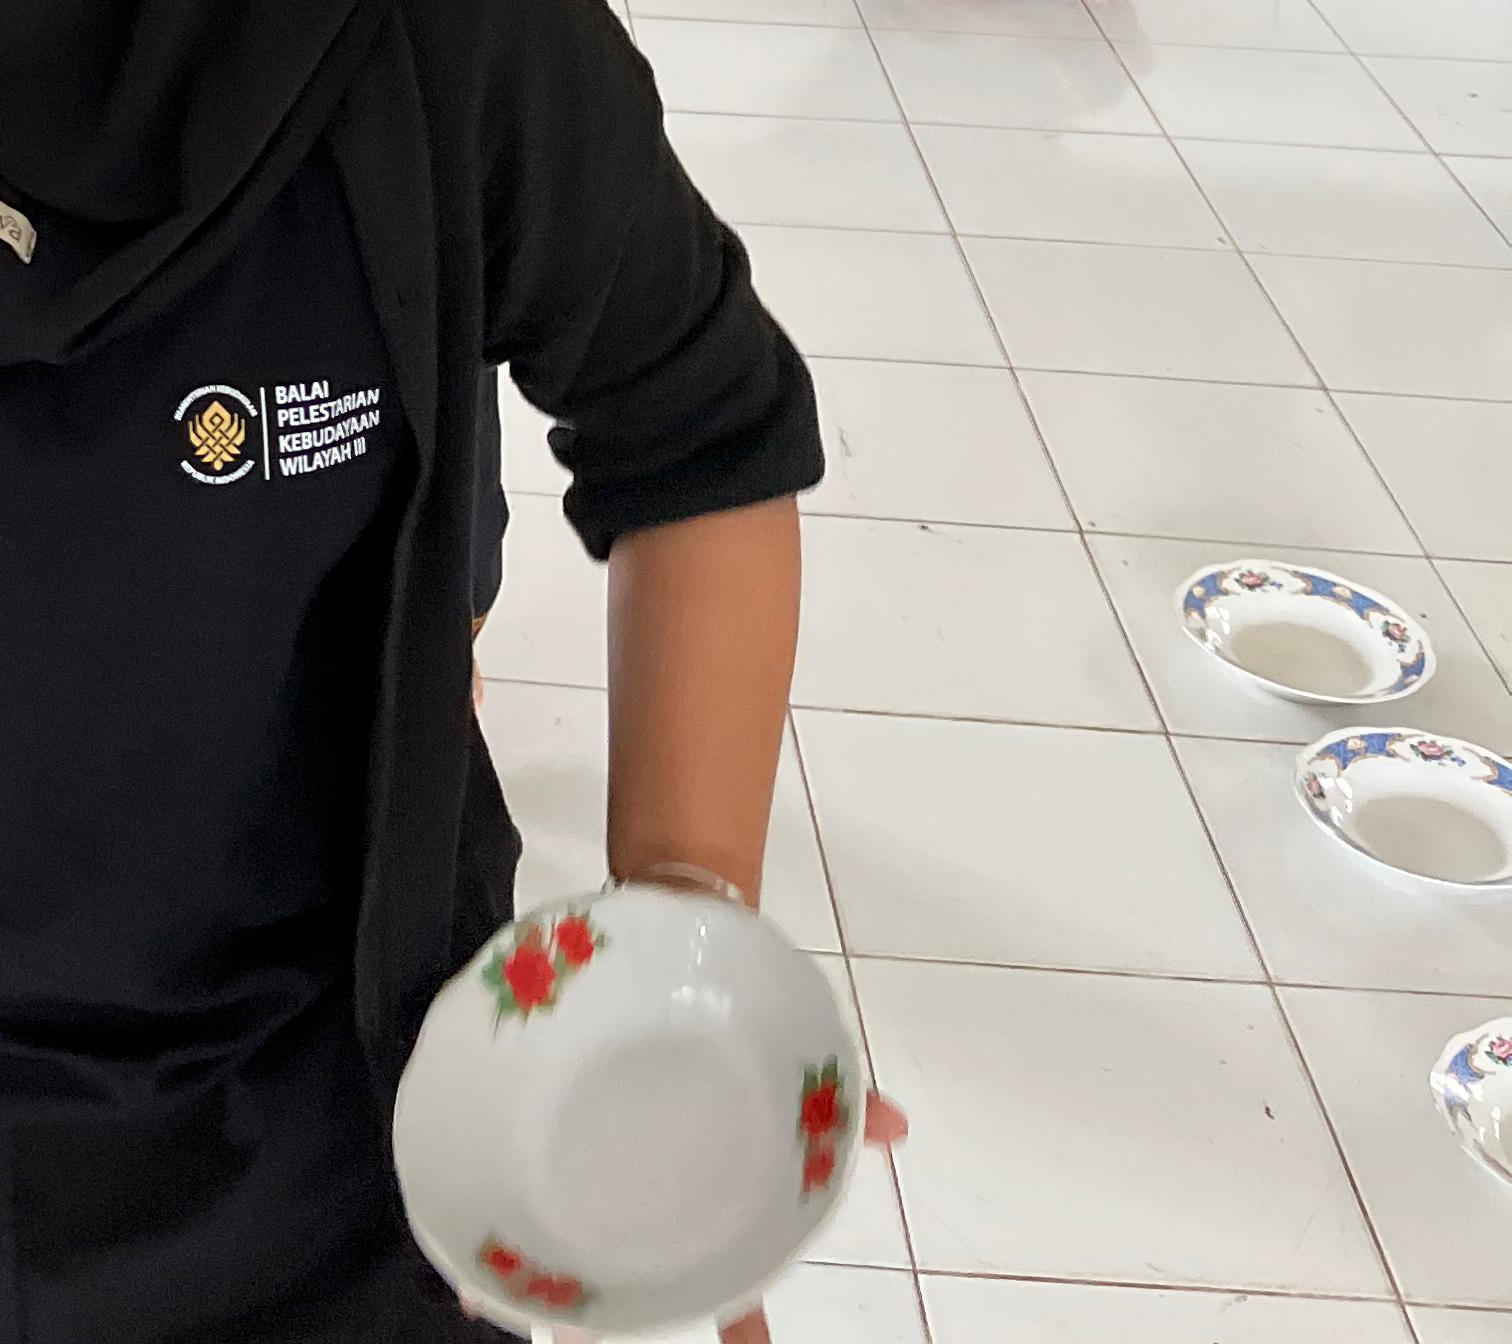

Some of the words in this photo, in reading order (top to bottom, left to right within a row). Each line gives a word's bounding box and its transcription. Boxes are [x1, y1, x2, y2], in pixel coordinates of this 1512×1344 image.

[275, 380, 329, 404] BALAI
[277, 388, 381, 428] PELESTARIAN
[278, 410, 381, 453] KEBUDAYAAN
[279, 443, 352, 477] WILAYAH
[353, 436, 367, 457] III
